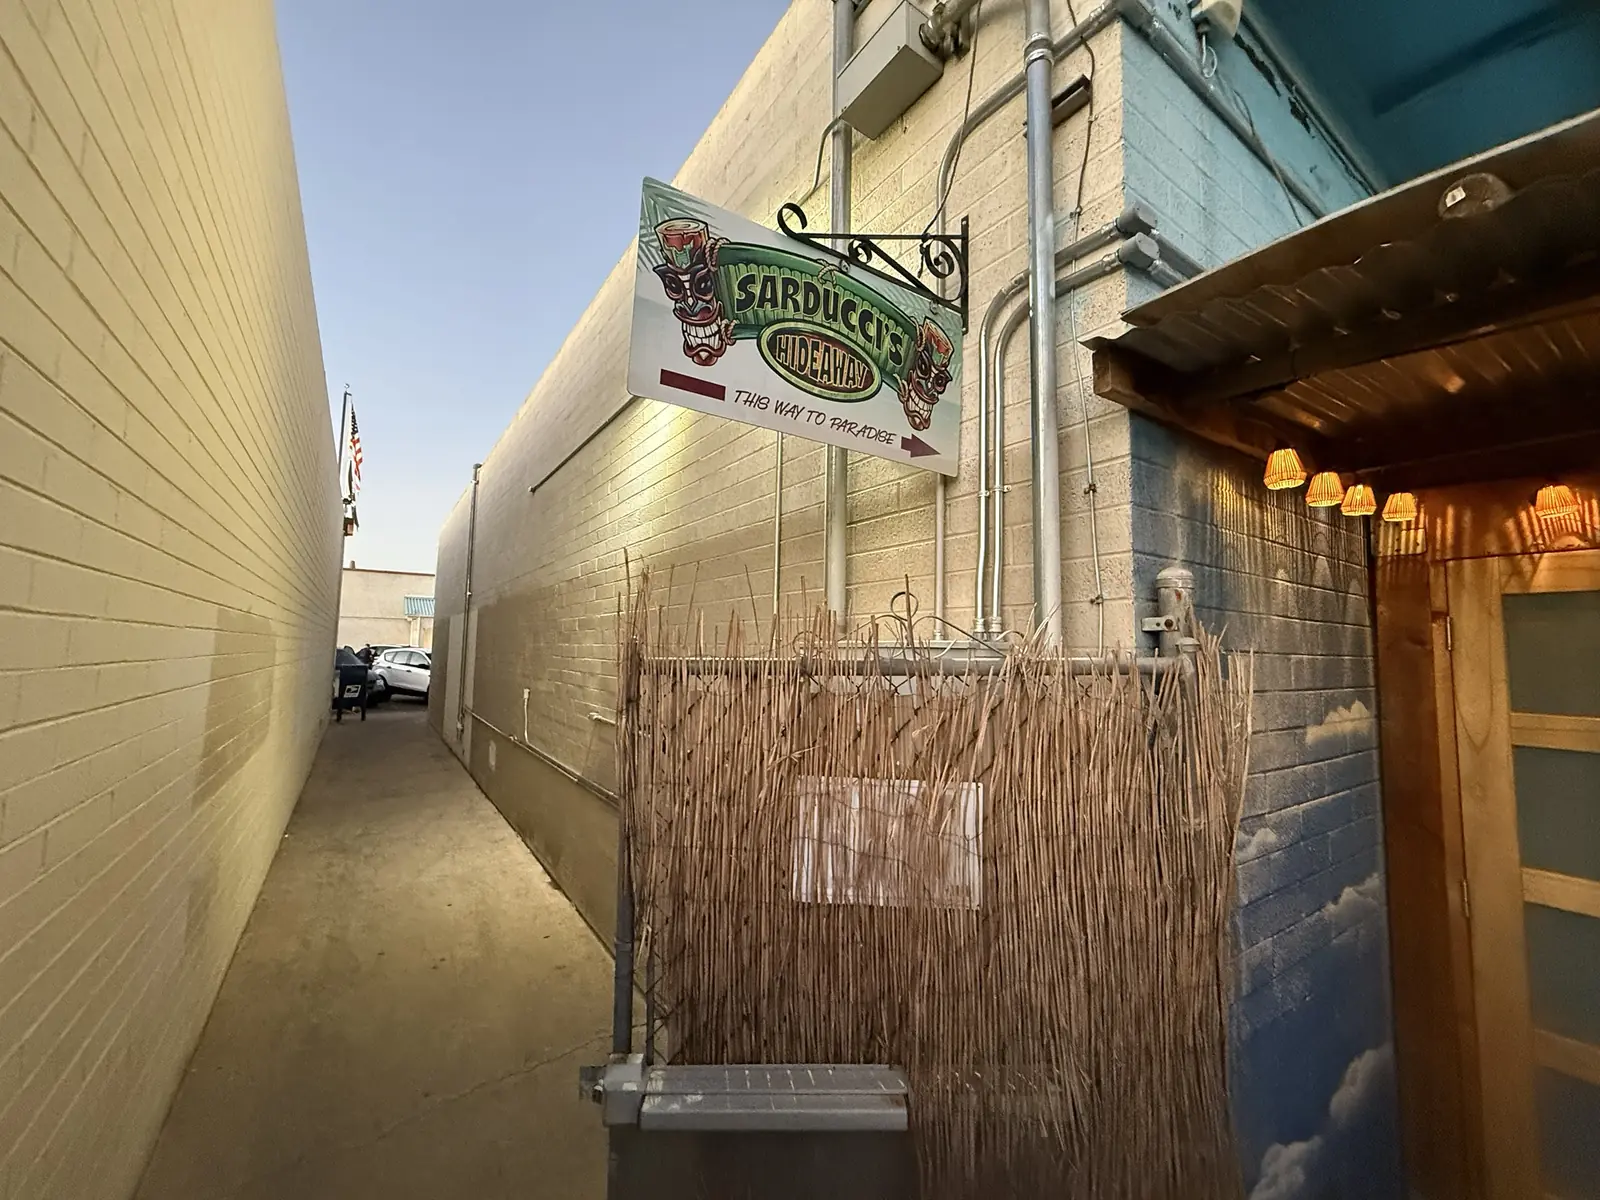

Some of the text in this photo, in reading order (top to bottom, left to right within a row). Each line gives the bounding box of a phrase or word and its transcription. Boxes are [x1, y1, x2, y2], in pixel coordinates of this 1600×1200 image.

[735, 273, 903, 366] SARDUCCI'S
[776, 334, 868, 388] HIDEAWAY
[735, 390, 897, 445] THIS WAY TO PARADISE
